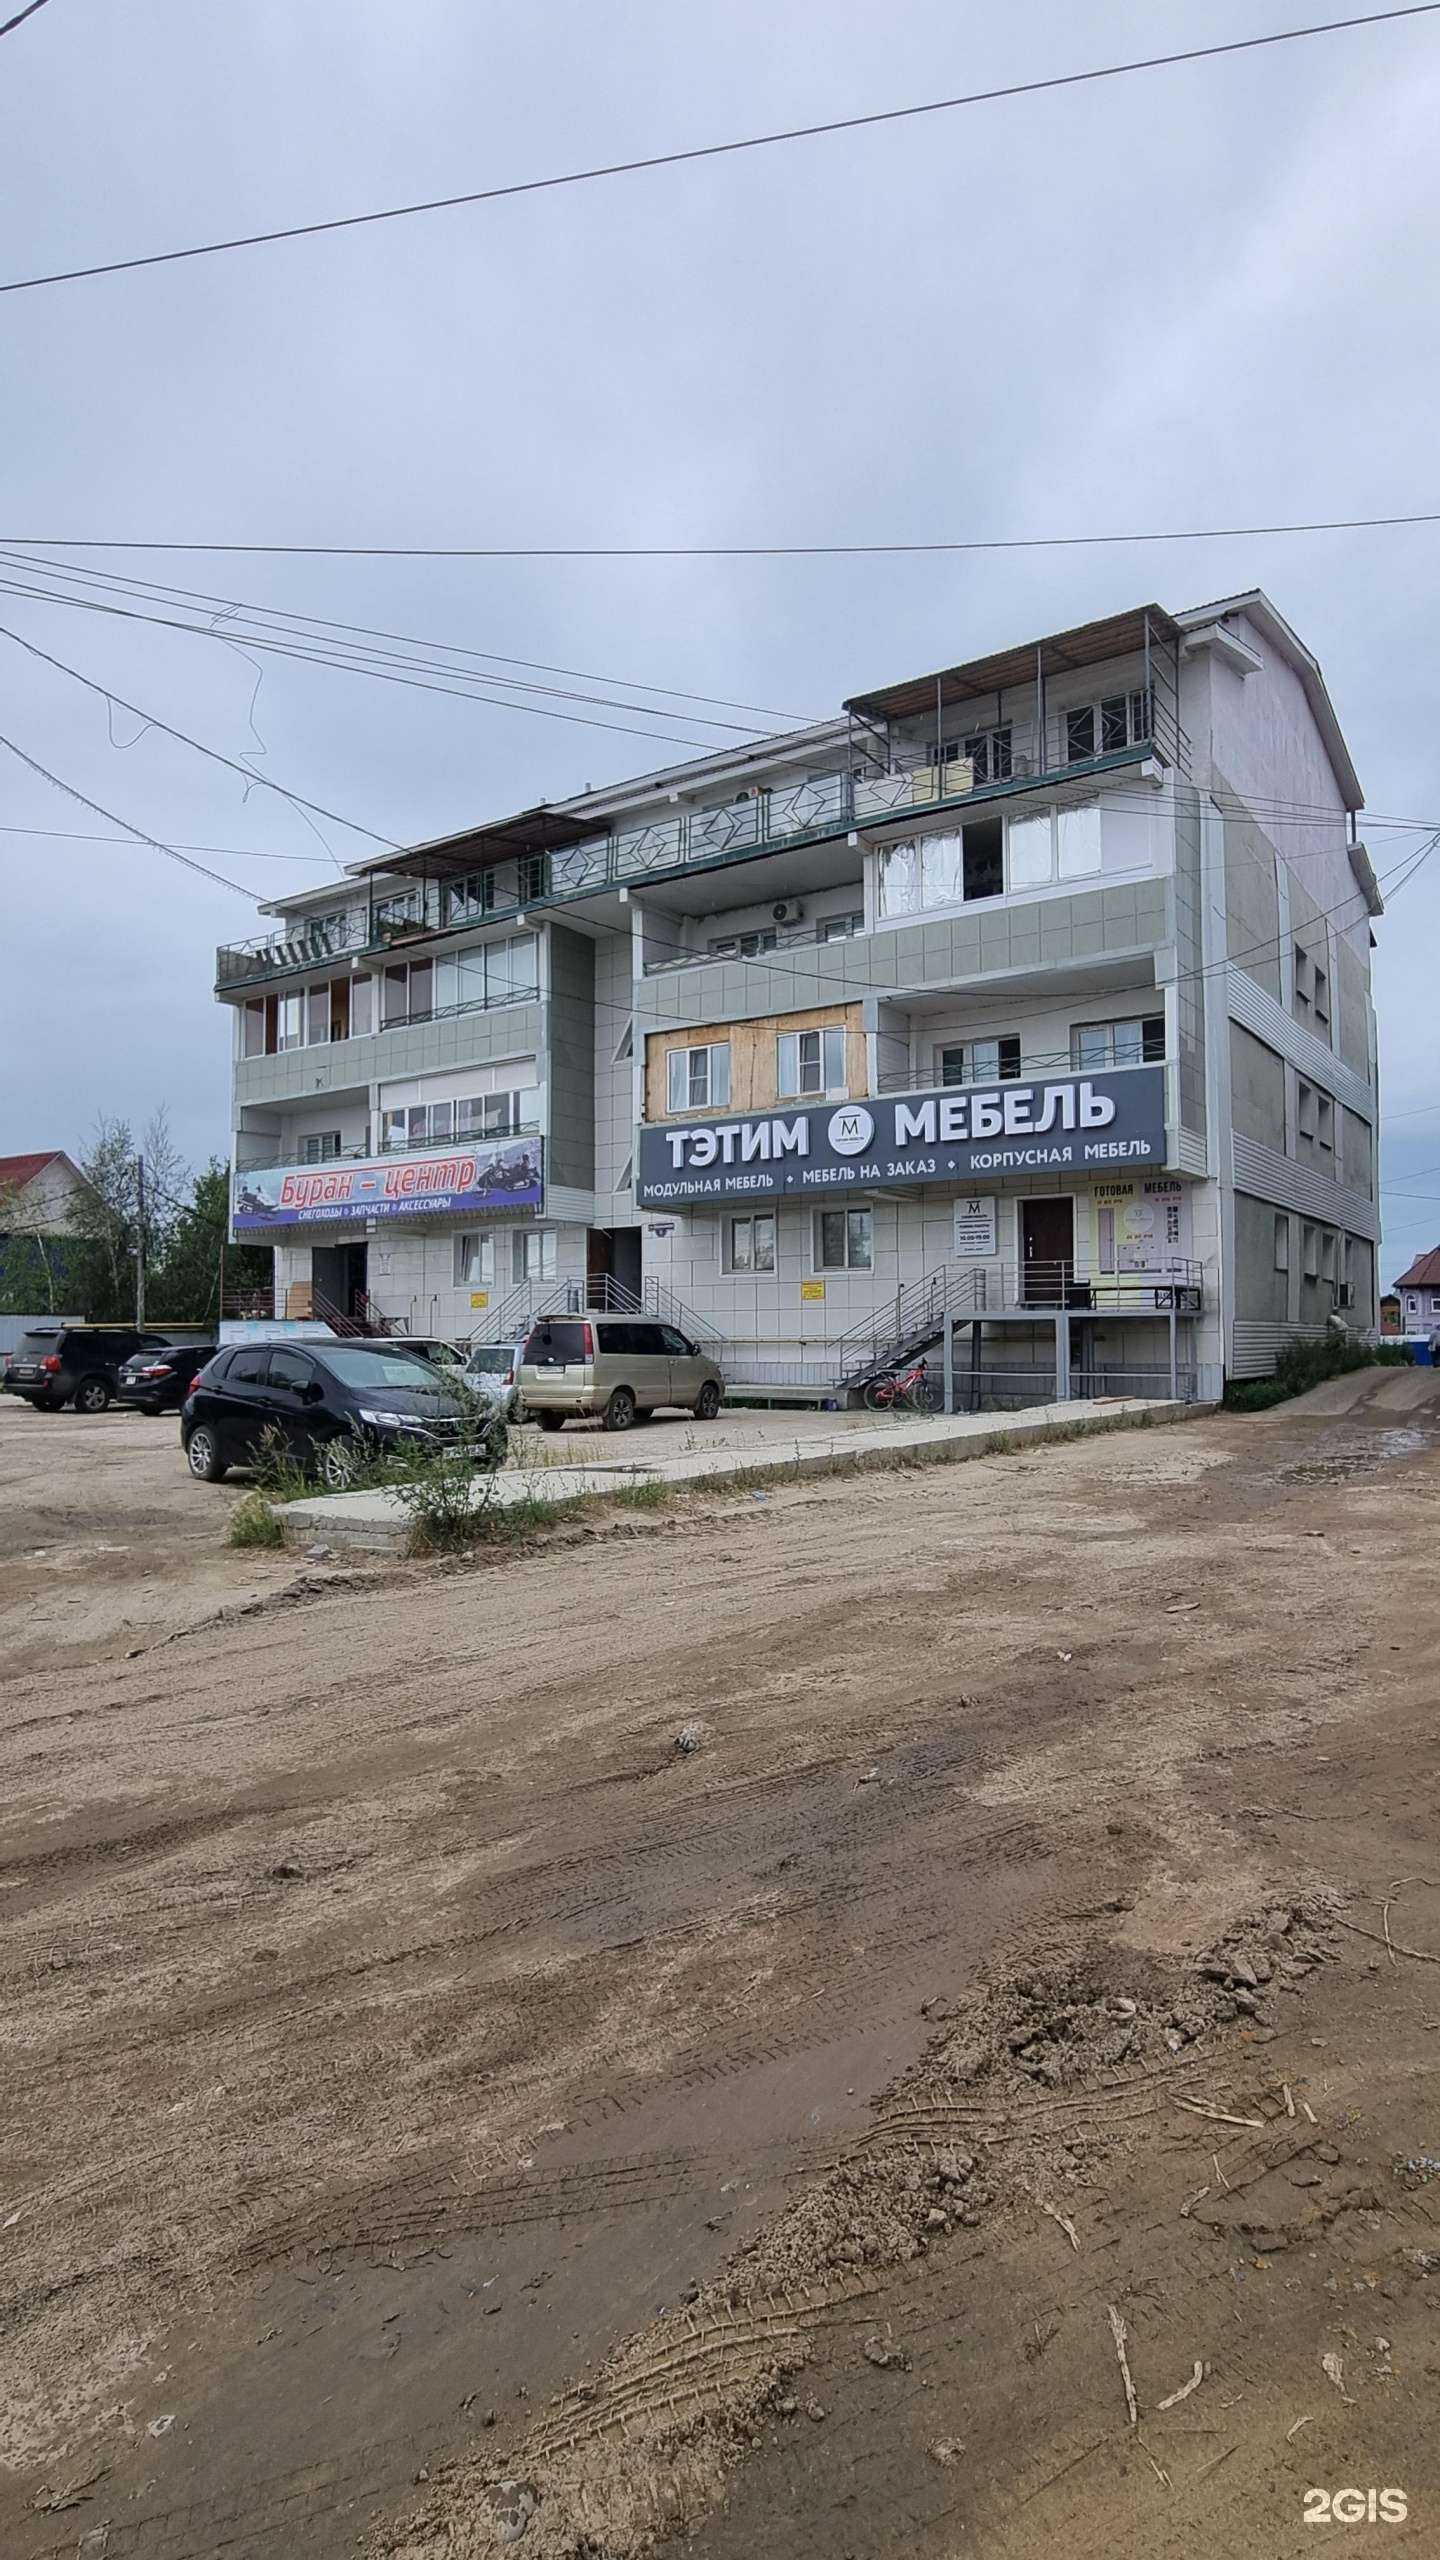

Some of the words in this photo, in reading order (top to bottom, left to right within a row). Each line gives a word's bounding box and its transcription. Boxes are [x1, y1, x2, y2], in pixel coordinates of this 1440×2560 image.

[894, 1082, 1115, 1146] МЕБЕЛЬ
[665, 1116, 810, 1169] ТЭТИМ
[280, 1175, 353, 1208] Буран
[383, 1159, 477, 1200] центр
[643, 1178, 721, 1197] МОДУЛЬНАЯ
[725, 1174, 774, 1191] МЕБЕЛЬ
[802, 1167, 856, 1184] МЕБЕЛЬ
[860, 1164, 881, 1179] НА
[887, 1159, 936, 1177] ЗАКАЗ
[970, 1146, 1073, 1170] КОРПУСНАЯ
[1084, 1140, 1151, 1160] МЕБЕЛЬ
[1094, 1184, 1134, 1197] ГОТОВАЯ
[1144, 1181, 1182, 1194] МЕБЕЛЬ
[298, 1208, 343, 1220] СНЕГОХОДЫ
[351, 1204, 390, 1217] ЗАПЧАСТИ
[399, 1199, 451, 1212] АКСЕССУАРЫ
